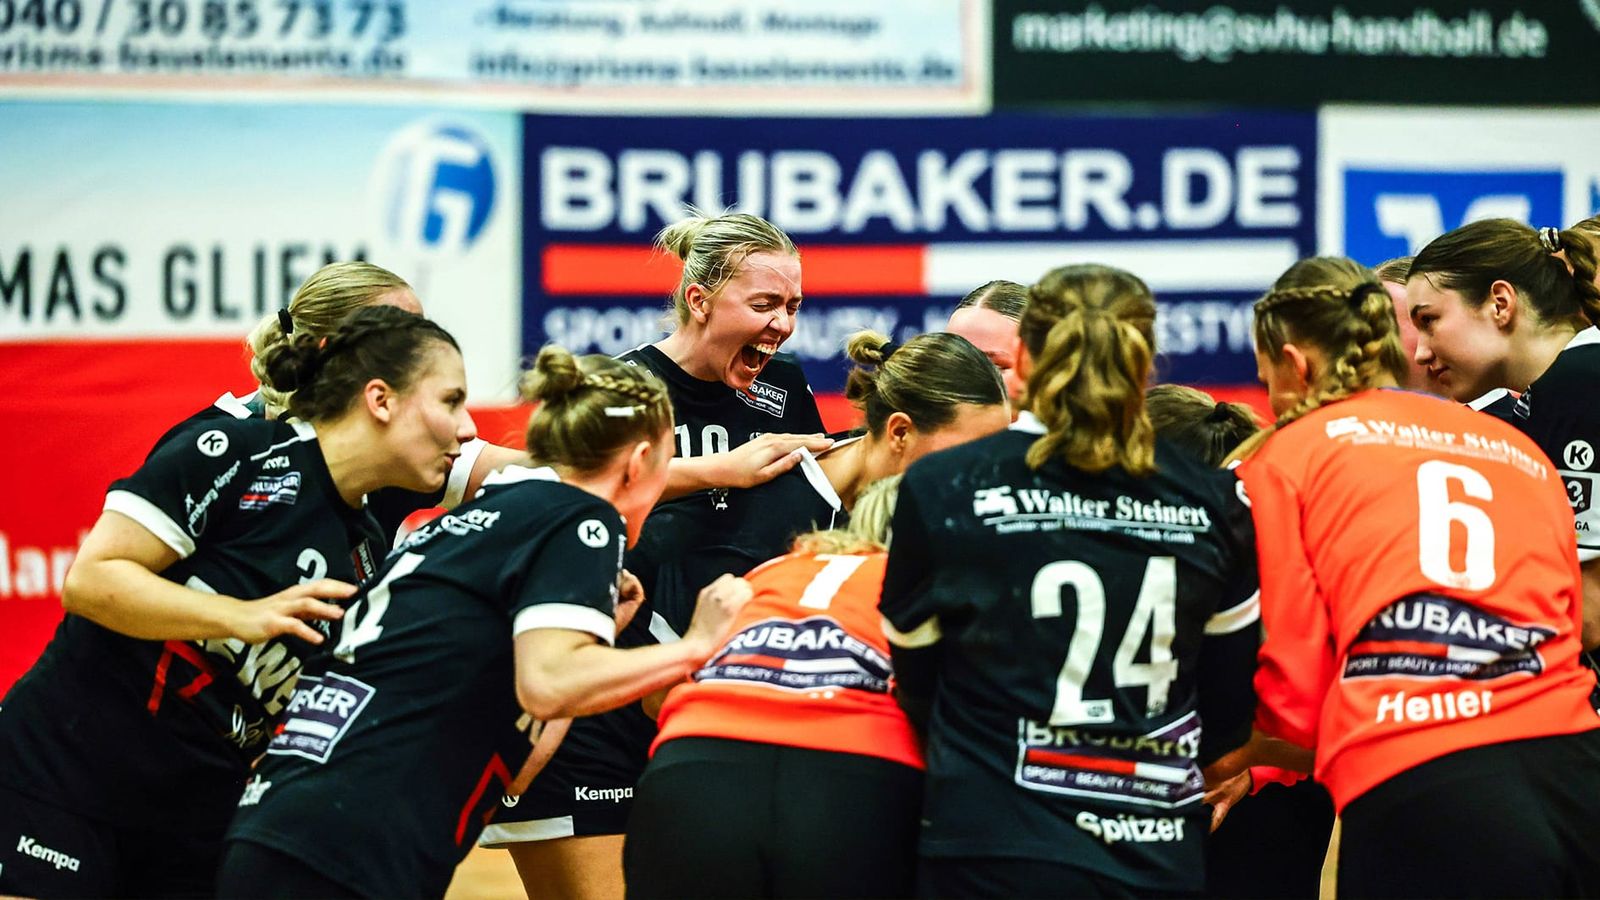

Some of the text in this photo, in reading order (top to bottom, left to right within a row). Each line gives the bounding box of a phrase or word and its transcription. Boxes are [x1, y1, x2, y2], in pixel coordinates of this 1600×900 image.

[541, 147, 1300, 233] BRUBAKER.DE
[1017, 489, 1111, 518] Walter
[1417, 459, 1496, 591] 6
[1031, 556, 1179, 726] 24
[1376, 690, 1493, 723] Heller
[574, 786, 634, 804] Kempa
[1076, 811, 1186, 844] Spitzer
[16, 835, 80, 873] Kempa
